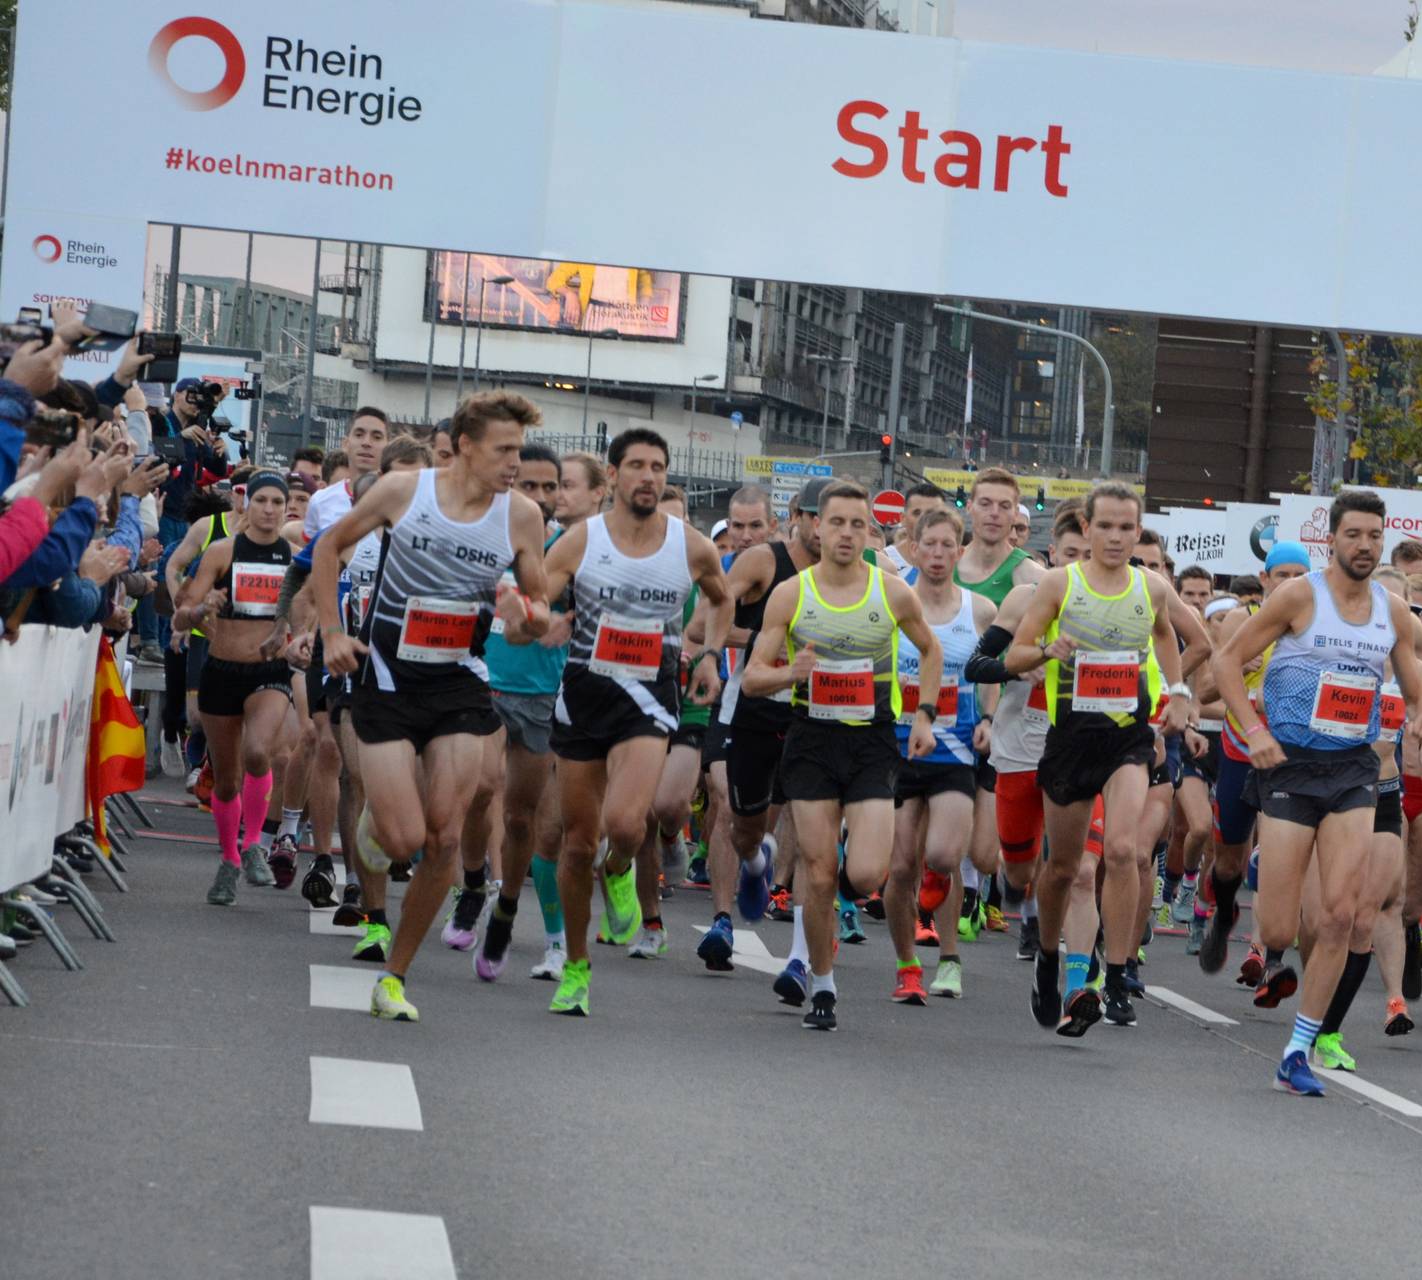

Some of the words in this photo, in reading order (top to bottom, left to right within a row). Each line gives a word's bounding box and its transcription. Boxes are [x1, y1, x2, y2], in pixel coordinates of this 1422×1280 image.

[264, 35, 383, 80] Rhein
[262, 73, 423, 126] Energie
[831, 99, 1072, 198] Start
[164, 147, 394, 191] #koelnmarathon
[66, 240, 106, 254] Rhein
[66, 252, 118, 269] Energie
[411, 535, 431, 552] LT
[455, 546, 498, 568] DSHS
[240, 575, 281, 589] F2219
[359, 570, 376, 583] LT
[599, 586, 617, 601] LT
[640, 588, 678, 604] DSHS
[607, 630, 654, 648] Hakim
[1328, 637, 1353, 649] TELIS
[1080, 667, 1135, 679] Frederik
[818, 675, 867, 689] Marius
[1330, 689, 1368, 705] Kevin
